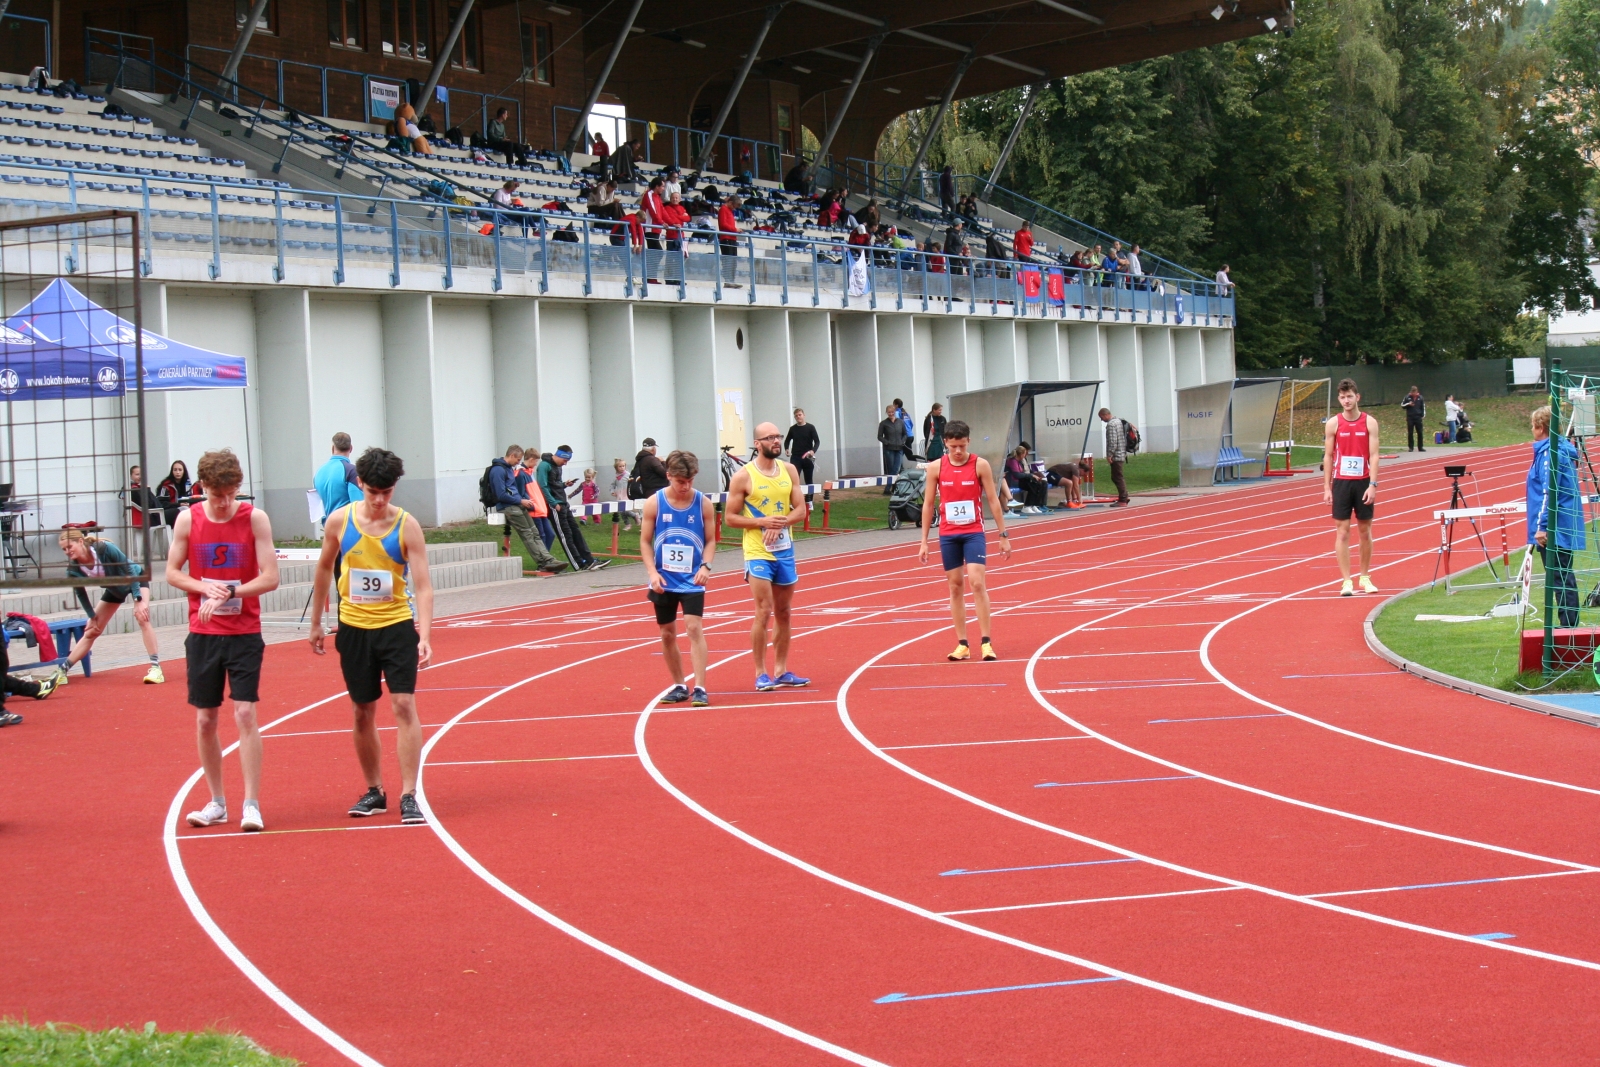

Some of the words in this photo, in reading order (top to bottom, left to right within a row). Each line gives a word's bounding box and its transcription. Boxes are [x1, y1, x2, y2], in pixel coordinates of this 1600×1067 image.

[158, 364, 187, 378] GENERÁLNÍ
[188, 366, 213, 378] PARTNER
[1347, 460, 1358, 469] 32
[953, 506, 966, 516] 34
[212, 545, 229, 566] S
[669, 550, 684, 562] 35
[362, 577, 381, 592] 39
